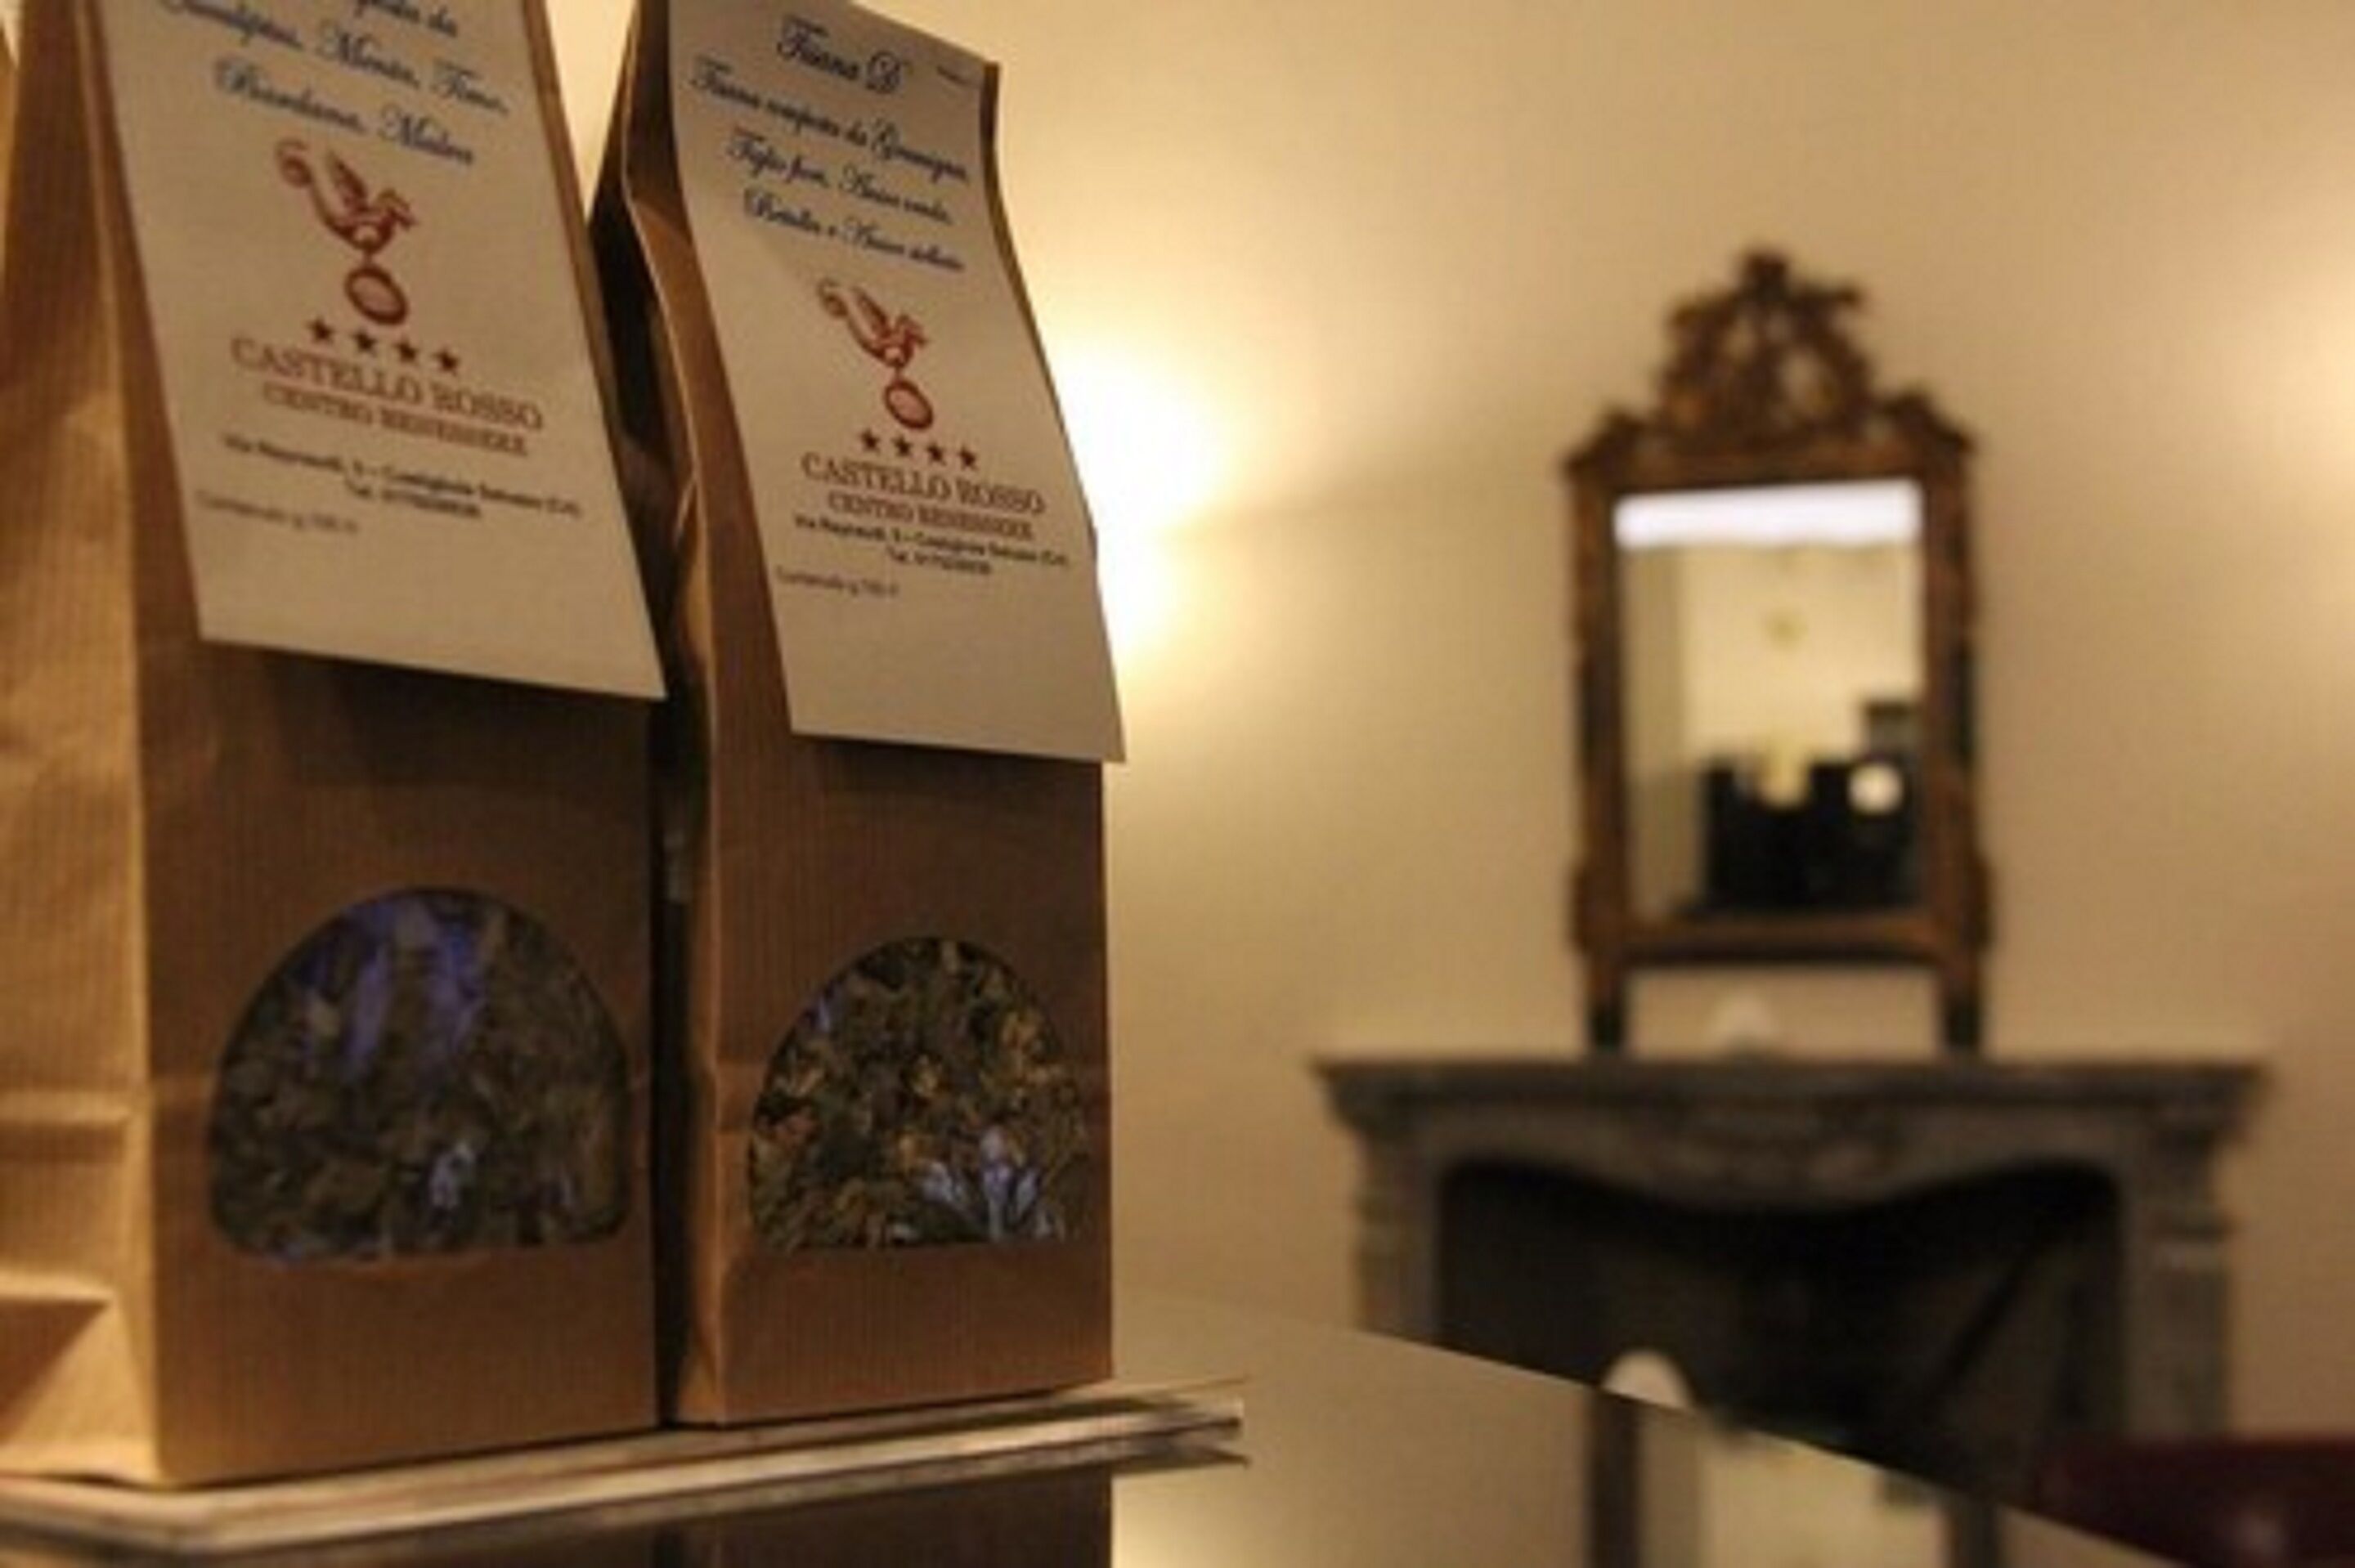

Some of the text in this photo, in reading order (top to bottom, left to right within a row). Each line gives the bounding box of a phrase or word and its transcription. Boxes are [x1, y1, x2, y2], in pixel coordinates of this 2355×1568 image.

[231, 336, 545, 430] CASTELLO ROSSO
[263, 380, 373, 424] CENTRO
[801, 451, 1047, 515] CASTELLO ROSSO
[828, 491, 913, 522] CENTRO
